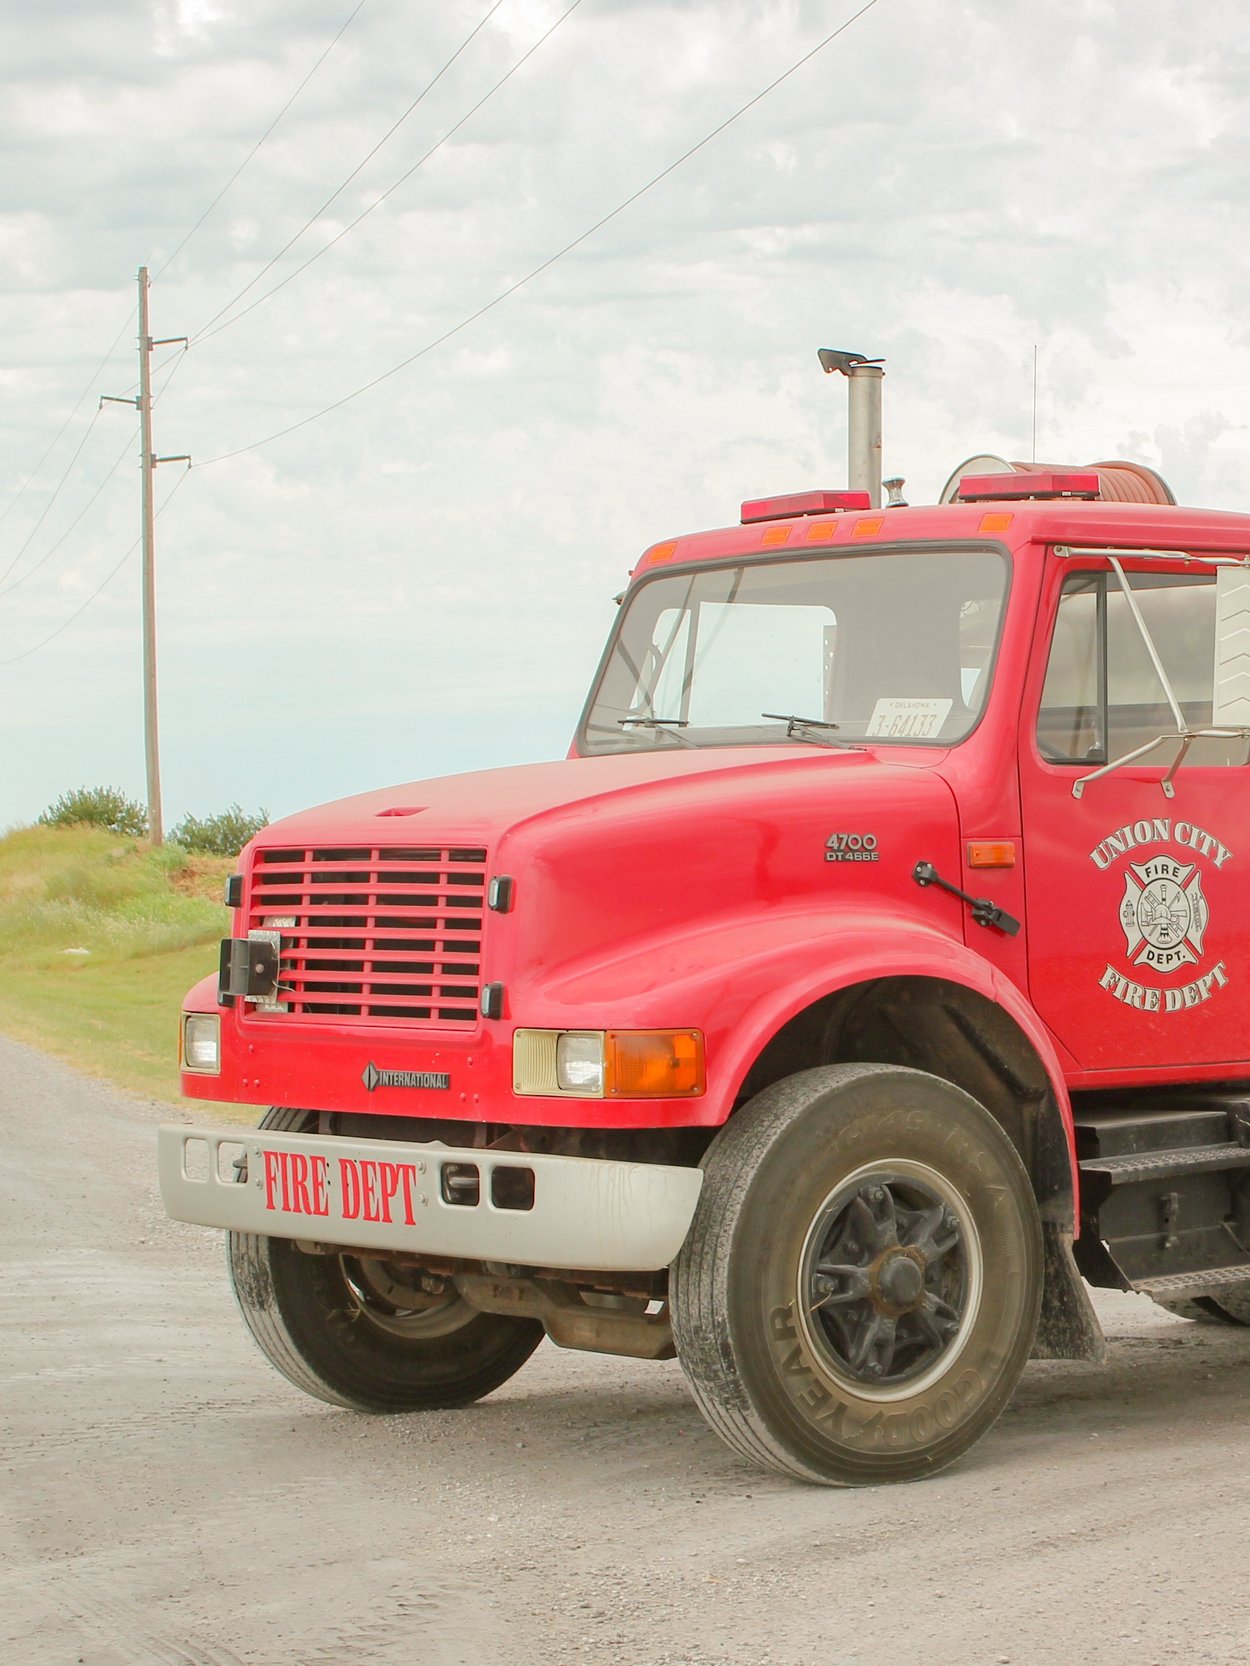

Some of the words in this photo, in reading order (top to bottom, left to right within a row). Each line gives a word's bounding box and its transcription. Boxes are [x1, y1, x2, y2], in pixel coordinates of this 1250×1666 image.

[825, 833, 878, 850] 4700
[1089, 818, 1171, 870] UNION
[1173, 821, 1233, 870] CITY
[1145, 864, 1180, 878] FIRE
[1146, 950, 1186, 965] DEPT.
[1098, 963, 1161, 1013] FIRE
[1163, 960, 1229, 1013] DEPT
[379, 1070, 448, 1089] INTERNATIONAL
[263, 1150, 329, 1216] FIRE
[338, 1158, 417, 1226] DEPT
